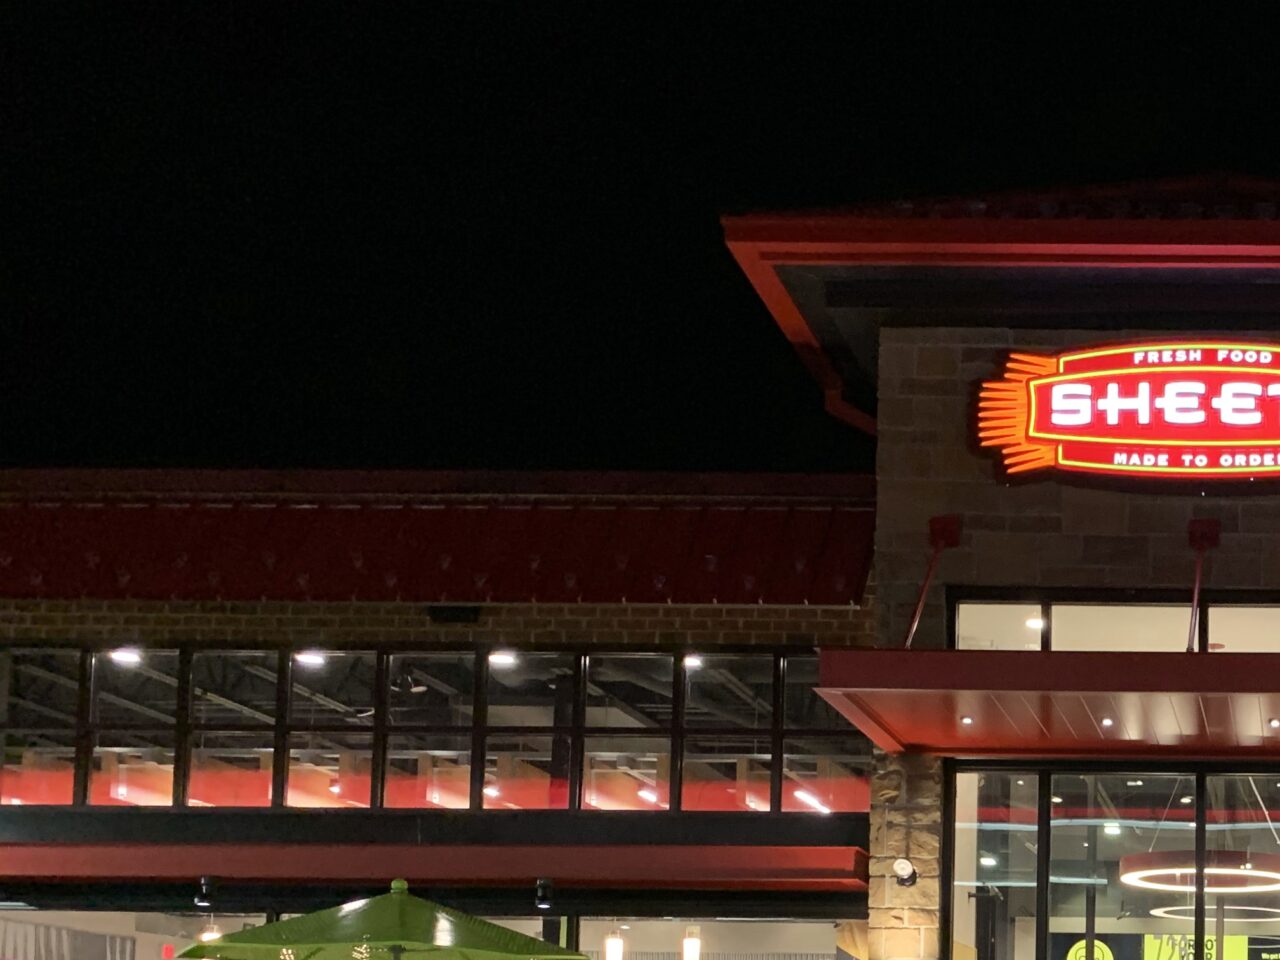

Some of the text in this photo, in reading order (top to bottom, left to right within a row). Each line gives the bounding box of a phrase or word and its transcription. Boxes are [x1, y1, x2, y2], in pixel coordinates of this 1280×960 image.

[1133, 349, 1273, 365] FRESH FOOD
[1113, 452, 1169, 467] MADE
[1181, 452, 1208, 467] TO
